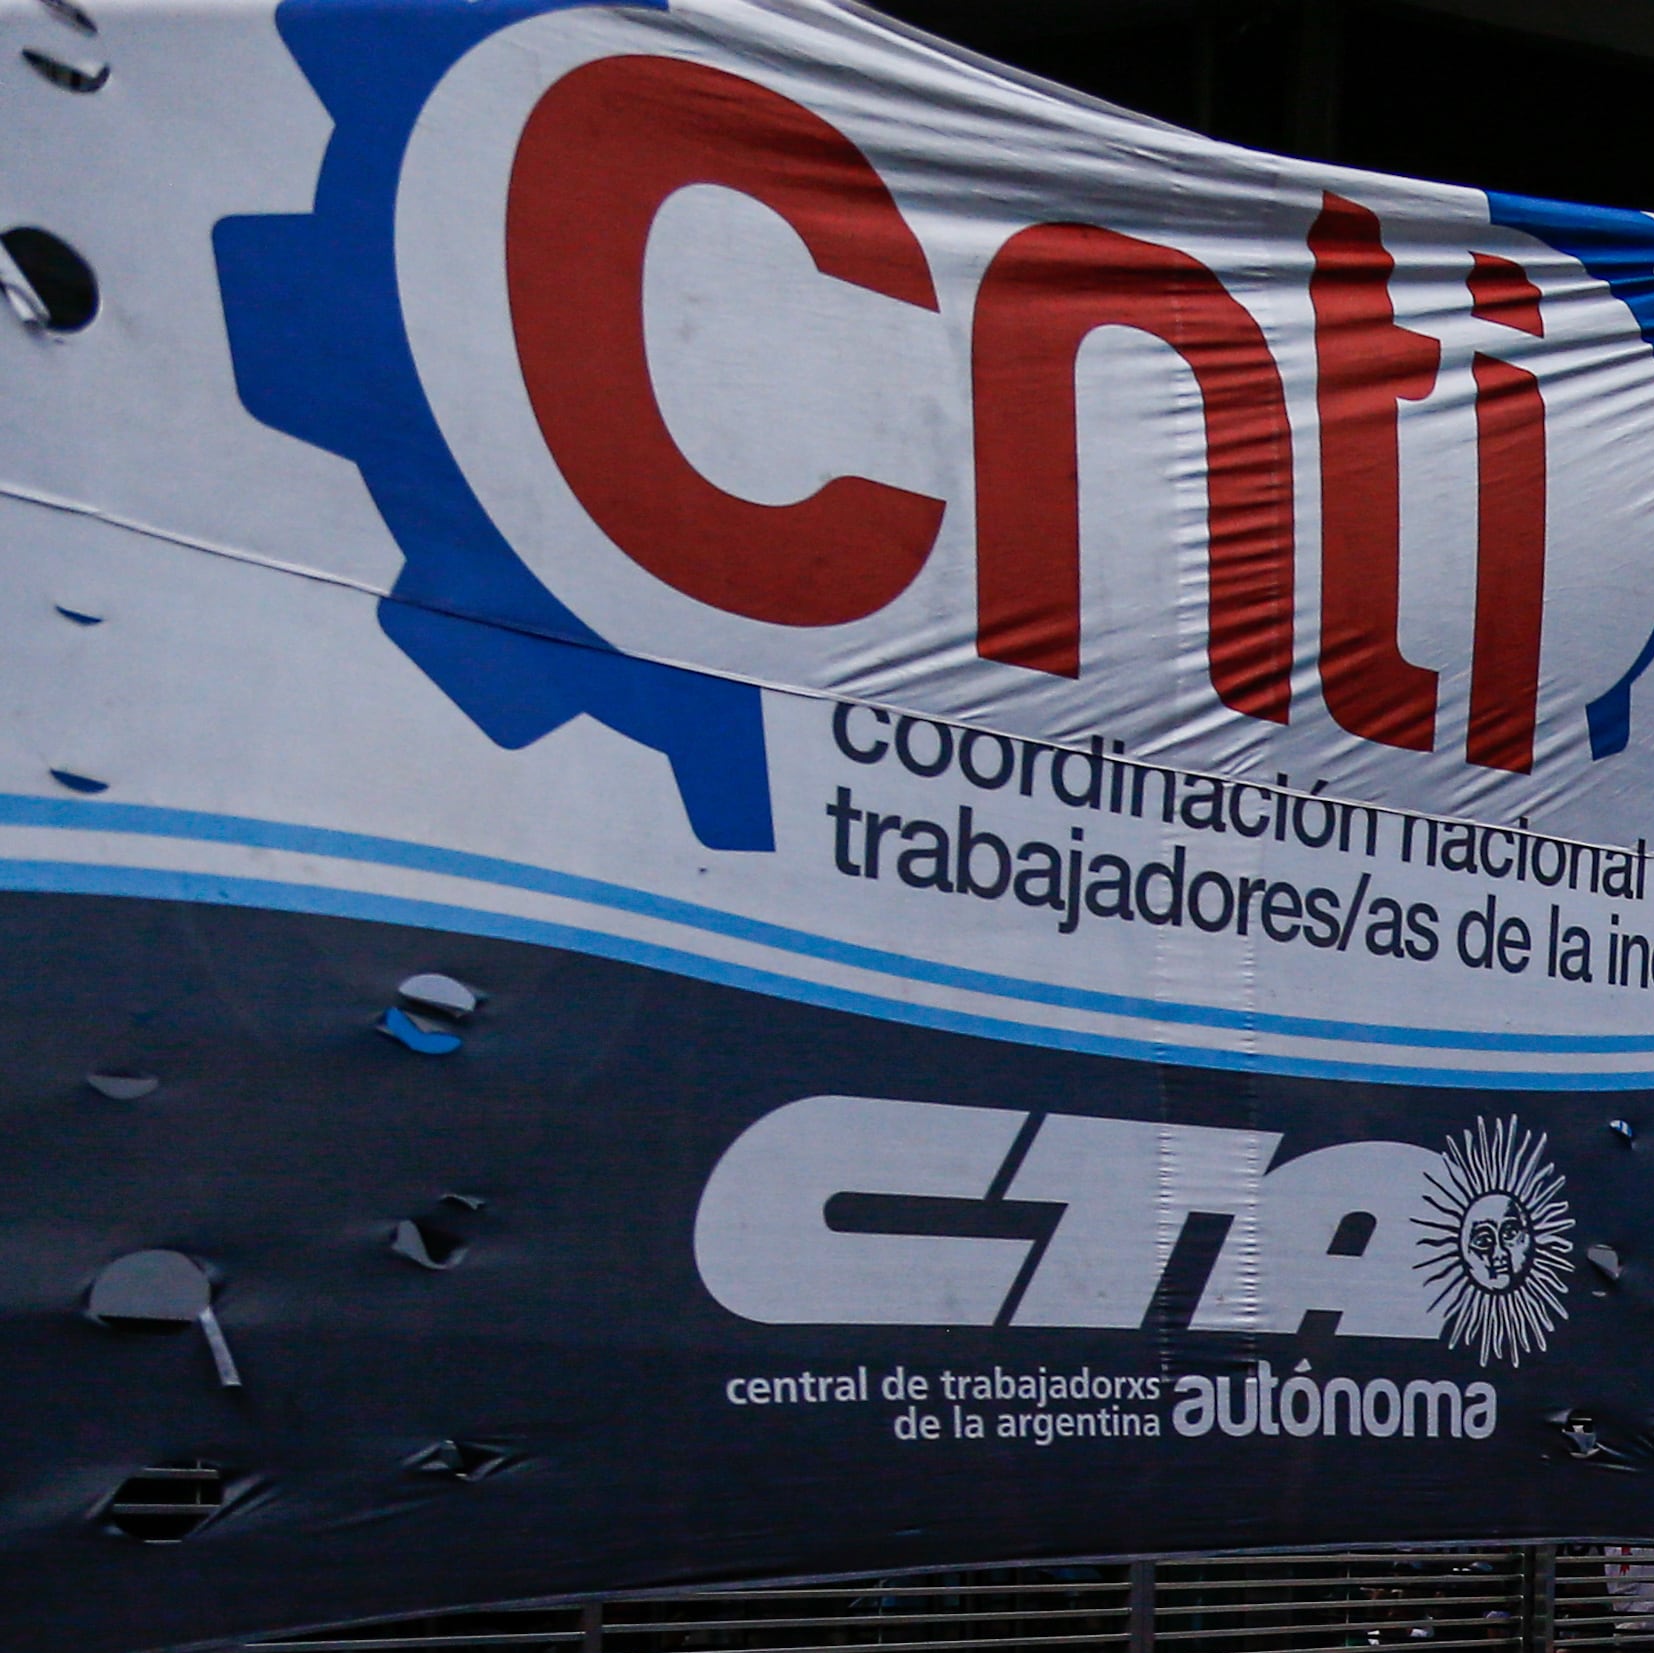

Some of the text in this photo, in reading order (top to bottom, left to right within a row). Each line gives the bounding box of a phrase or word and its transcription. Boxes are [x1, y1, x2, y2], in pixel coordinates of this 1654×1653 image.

[832, 700, 1378, 857] coordinación
[1401, 815, 1646, 900] nacional
[826, 786, 1440, 962] trabajadores/as
[1456, 894, 1532, 973] de
[1547, 903, 1593, 984] la
[693, 1094, 1452, 1340] CTA
[725, 1365, 1161, 1409] central de trabajadorxs
[893, 1406, 1161, 1446] de la argentina
[1172, 1358, 1497, 1440] autónoma
